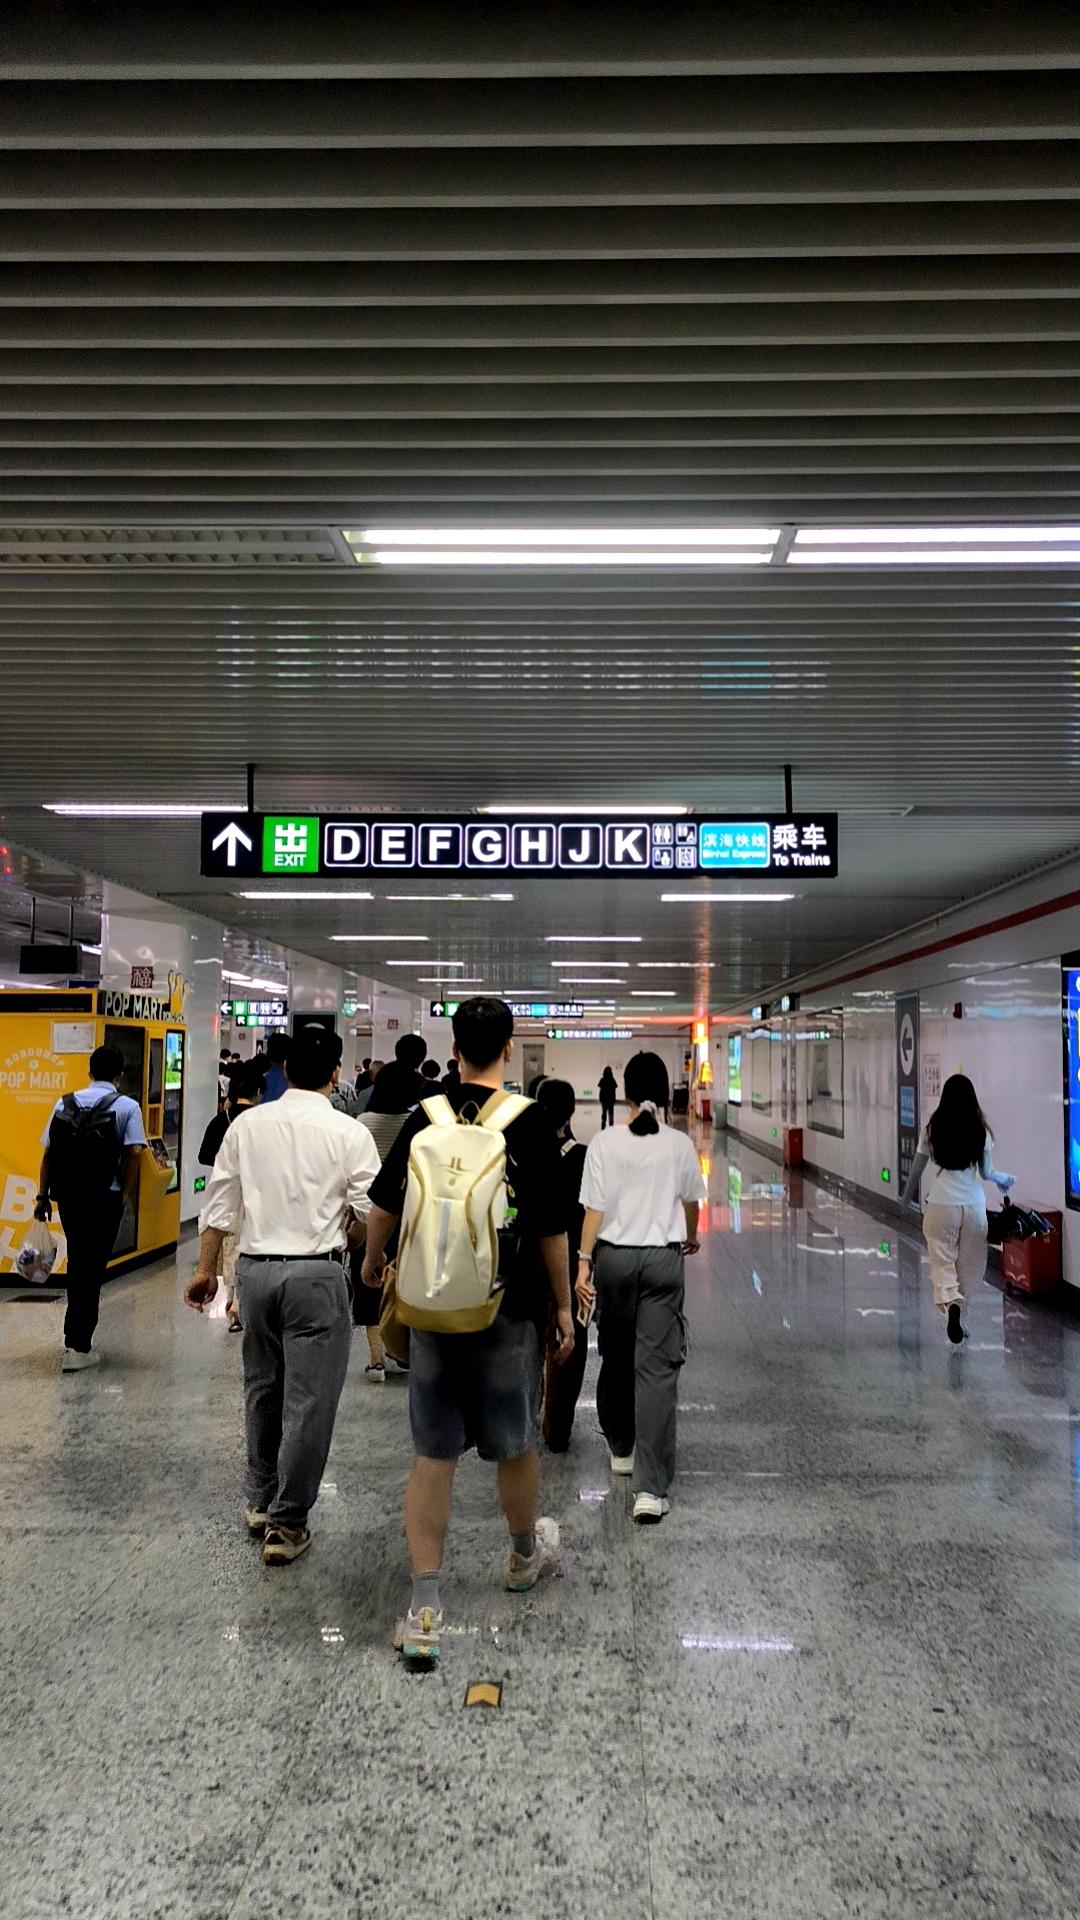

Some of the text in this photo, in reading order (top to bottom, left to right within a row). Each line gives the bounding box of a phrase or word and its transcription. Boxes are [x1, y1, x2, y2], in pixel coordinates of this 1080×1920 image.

[274, 823, 307, 852] 出
[333, 829, 643, 862] D E F G H J K
[772, 824, 828, 850] 乘车
[274, 854, 305, 866] EXIT
[773, 853, 831, 866] To Trains
[105, 989, 163, 1021] POP MART
[0, 1071, 69, 1089] POP MART
